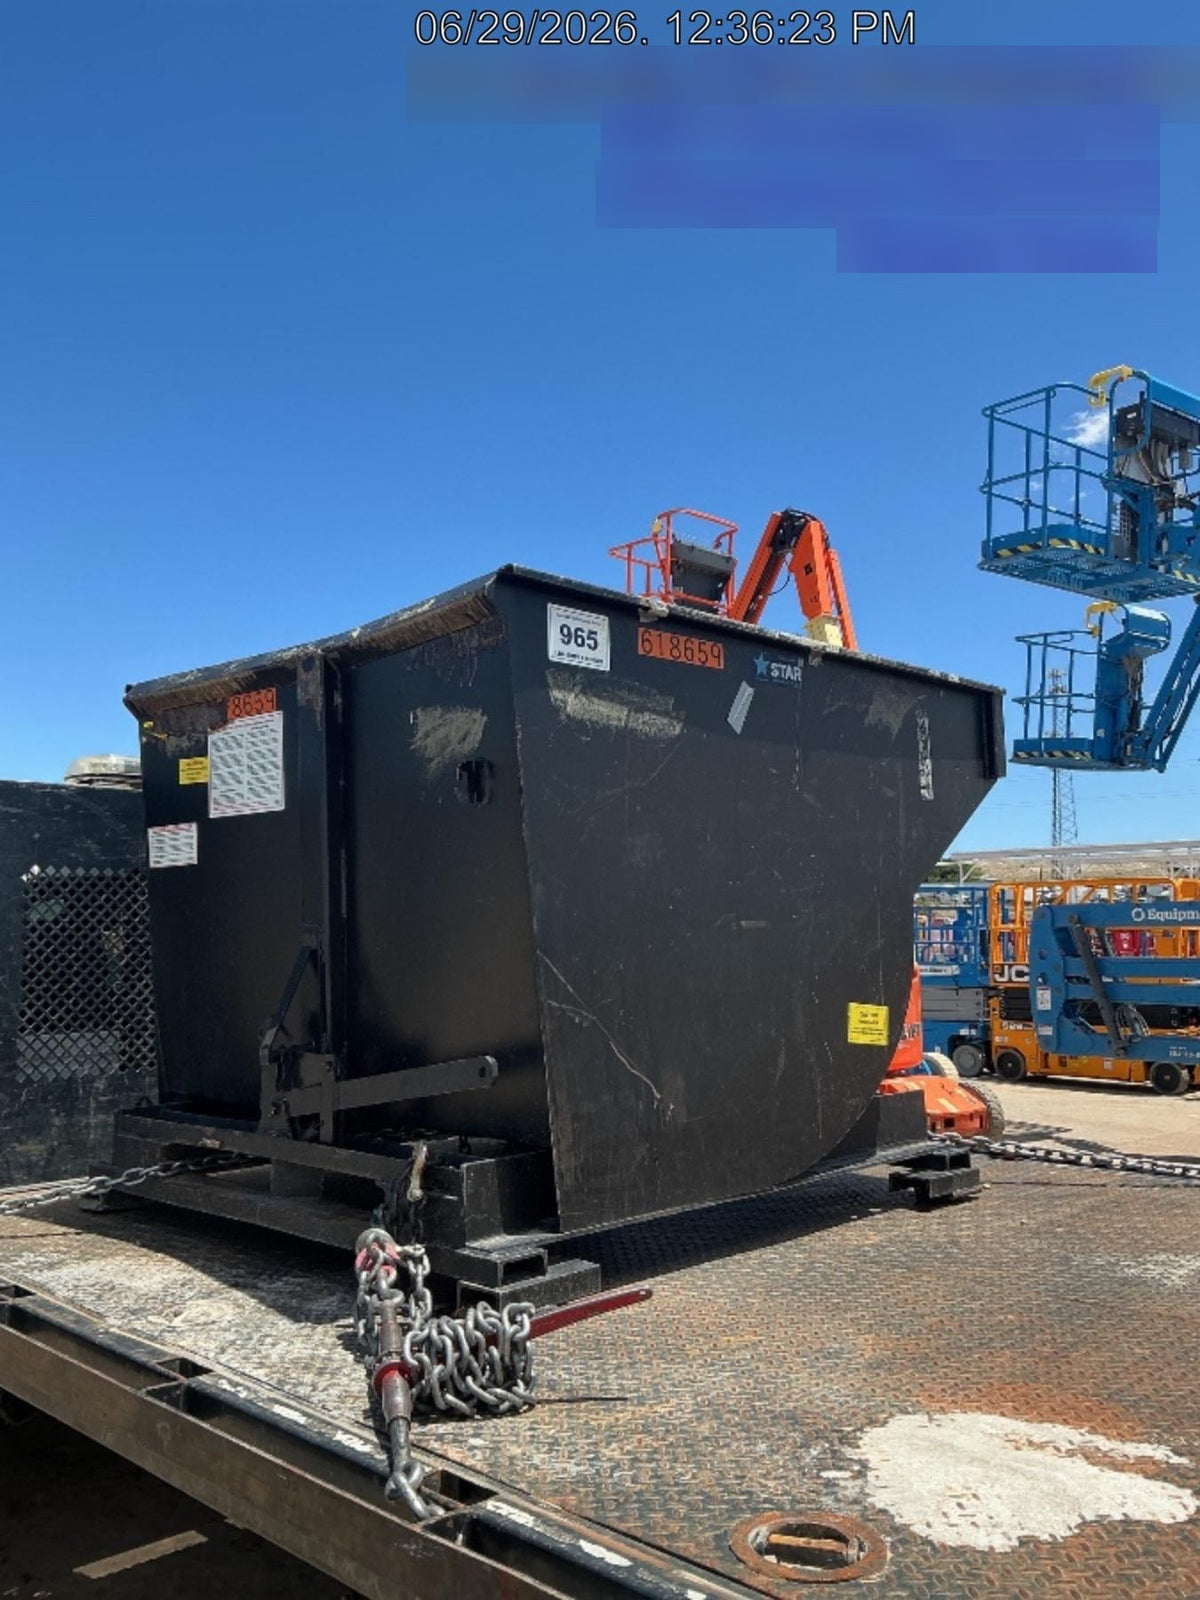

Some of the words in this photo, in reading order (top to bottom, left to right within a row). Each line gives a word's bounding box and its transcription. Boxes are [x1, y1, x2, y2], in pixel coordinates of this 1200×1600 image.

[559, 623, 599, 651] 965
[641, 628, 721, 667] 618659
[770, 662, 803, 682] STAR
